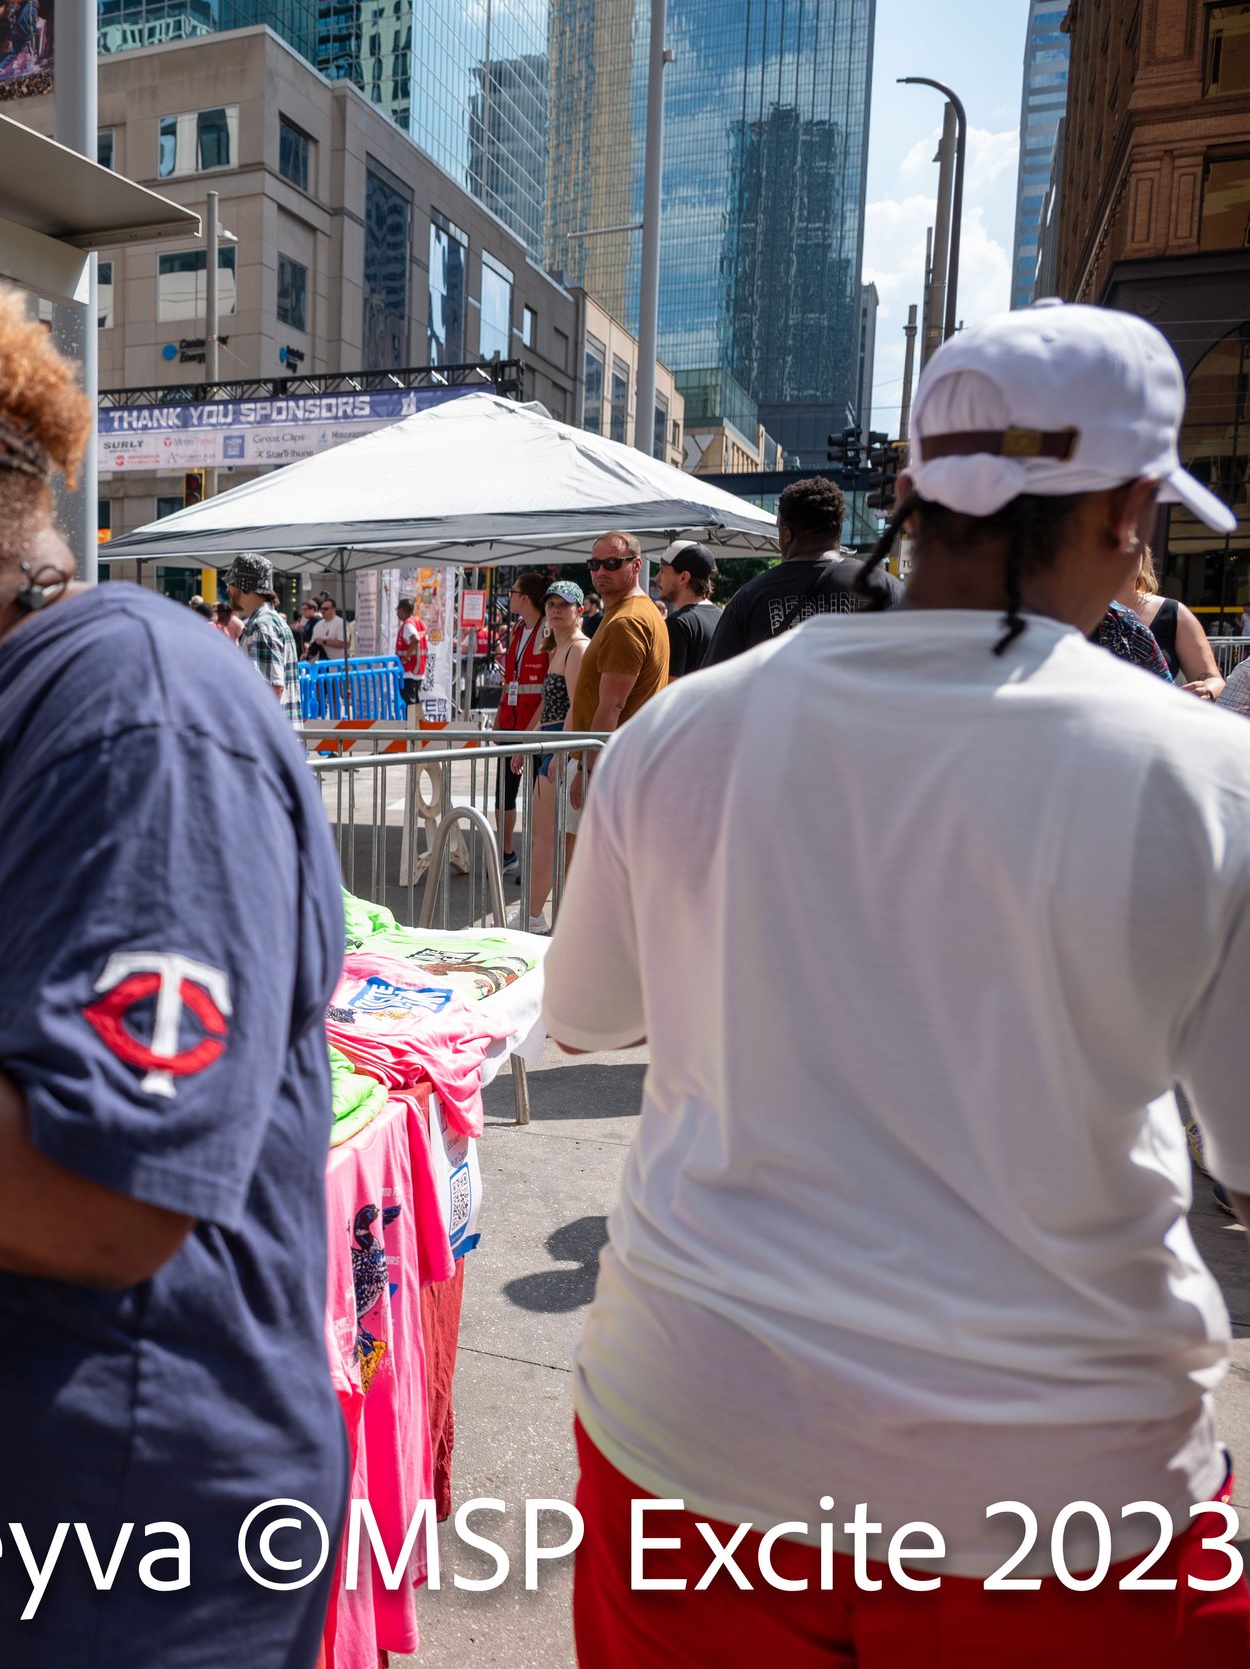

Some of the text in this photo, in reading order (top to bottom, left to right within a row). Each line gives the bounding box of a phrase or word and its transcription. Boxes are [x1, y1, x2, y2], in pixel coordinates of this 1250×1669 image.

[109, 395, 371, 429] THANK YOU SPONSORS
[253, 432, 306, 444] Great Clips
[103, 440, 144, 449] SURLY
